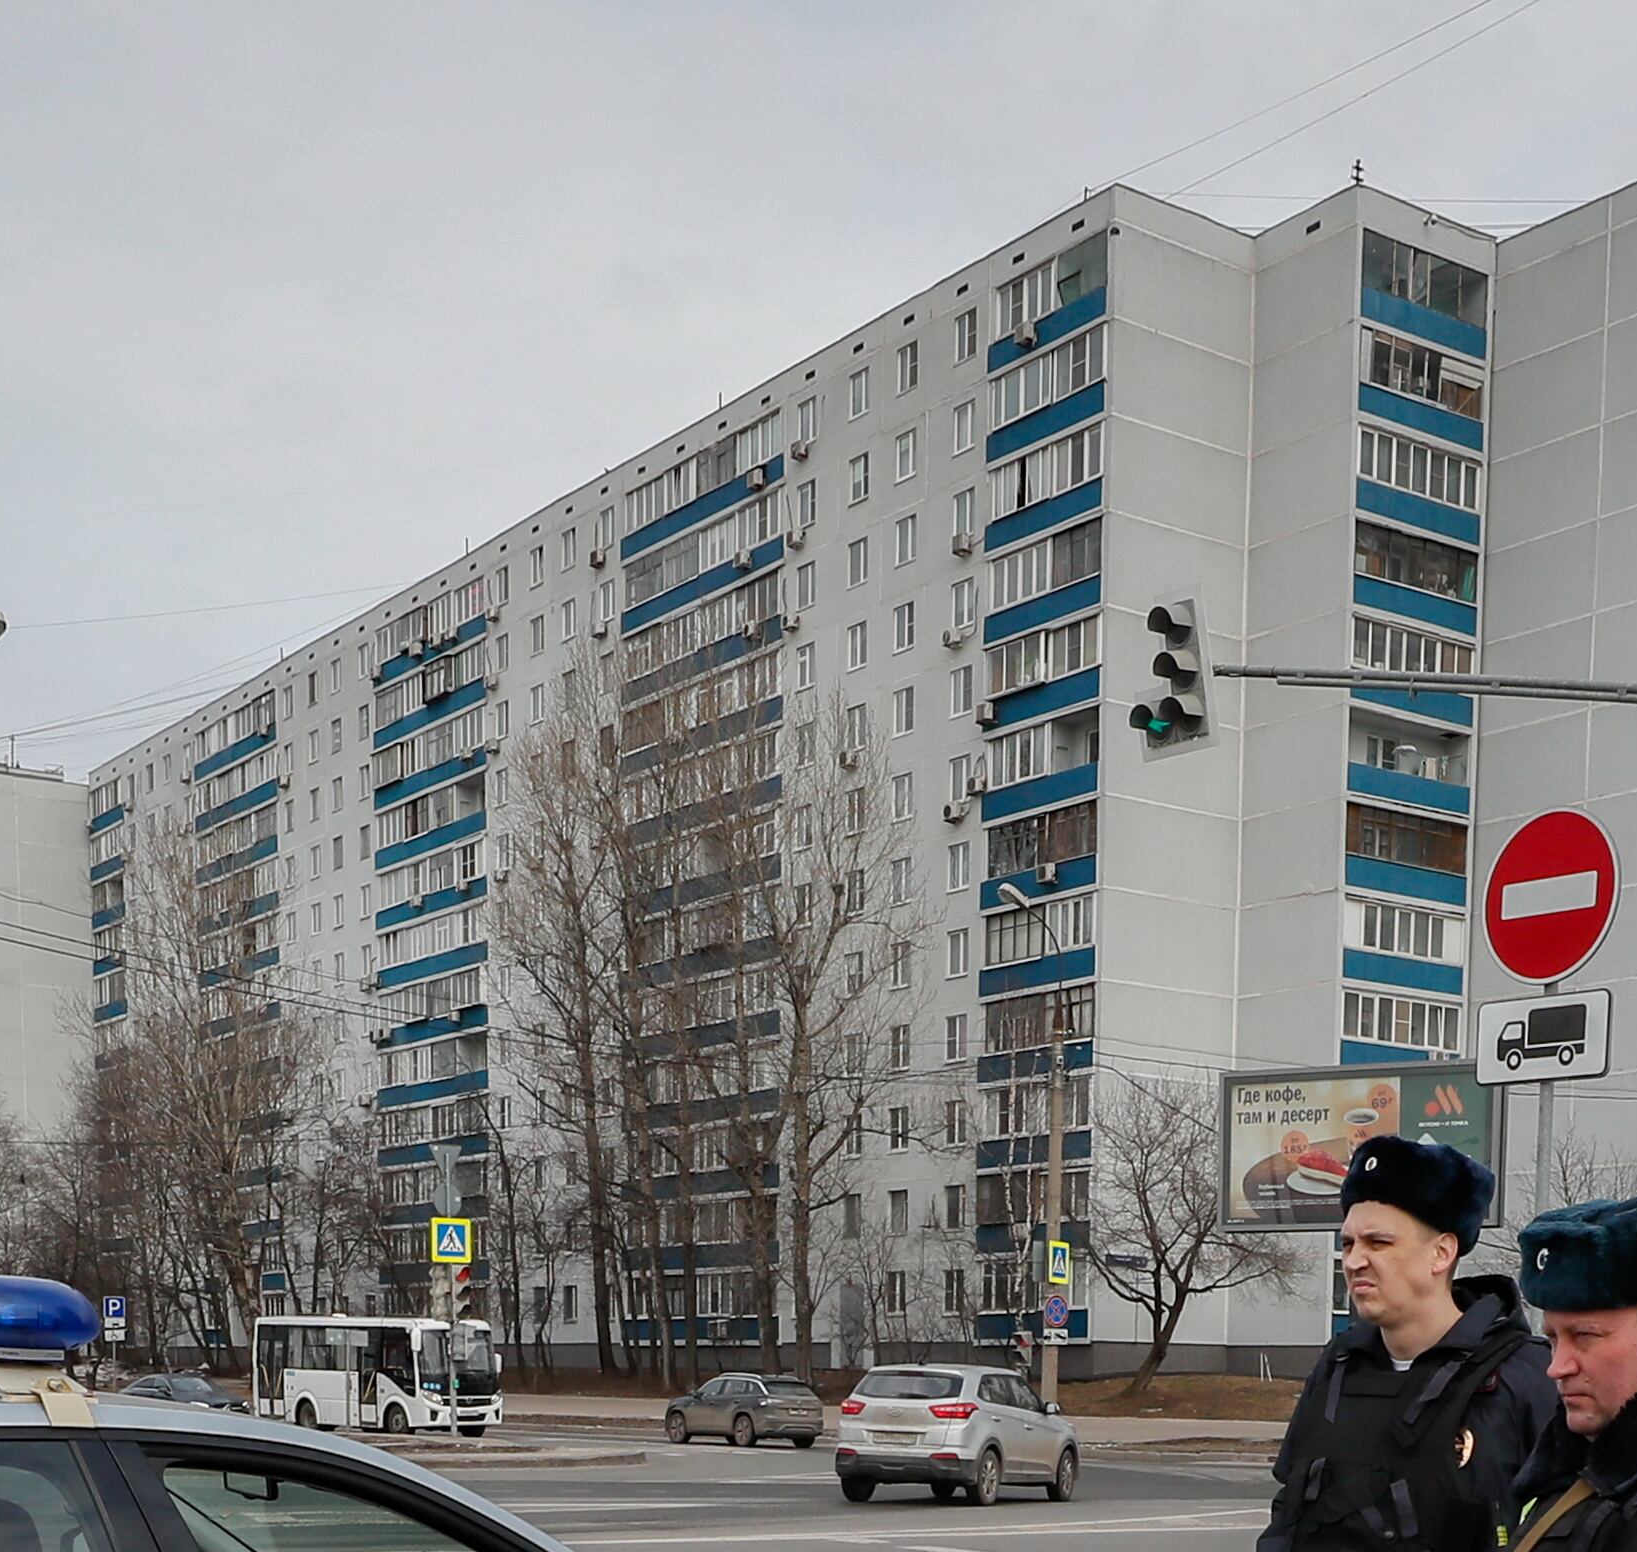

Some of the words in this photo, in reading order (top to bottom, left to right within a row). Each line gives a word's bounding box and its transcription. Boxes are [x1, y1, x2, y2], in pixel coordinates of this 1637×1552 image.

[1237, 1087, 1261, 1106] Где
[1265, 1085, 1306, 1105] кофе,
[1236, 1111, 1262, 1125] там
[1267, 1110, 1276, 1123] и
[1280, 1108, 1330, 1126] десерт
